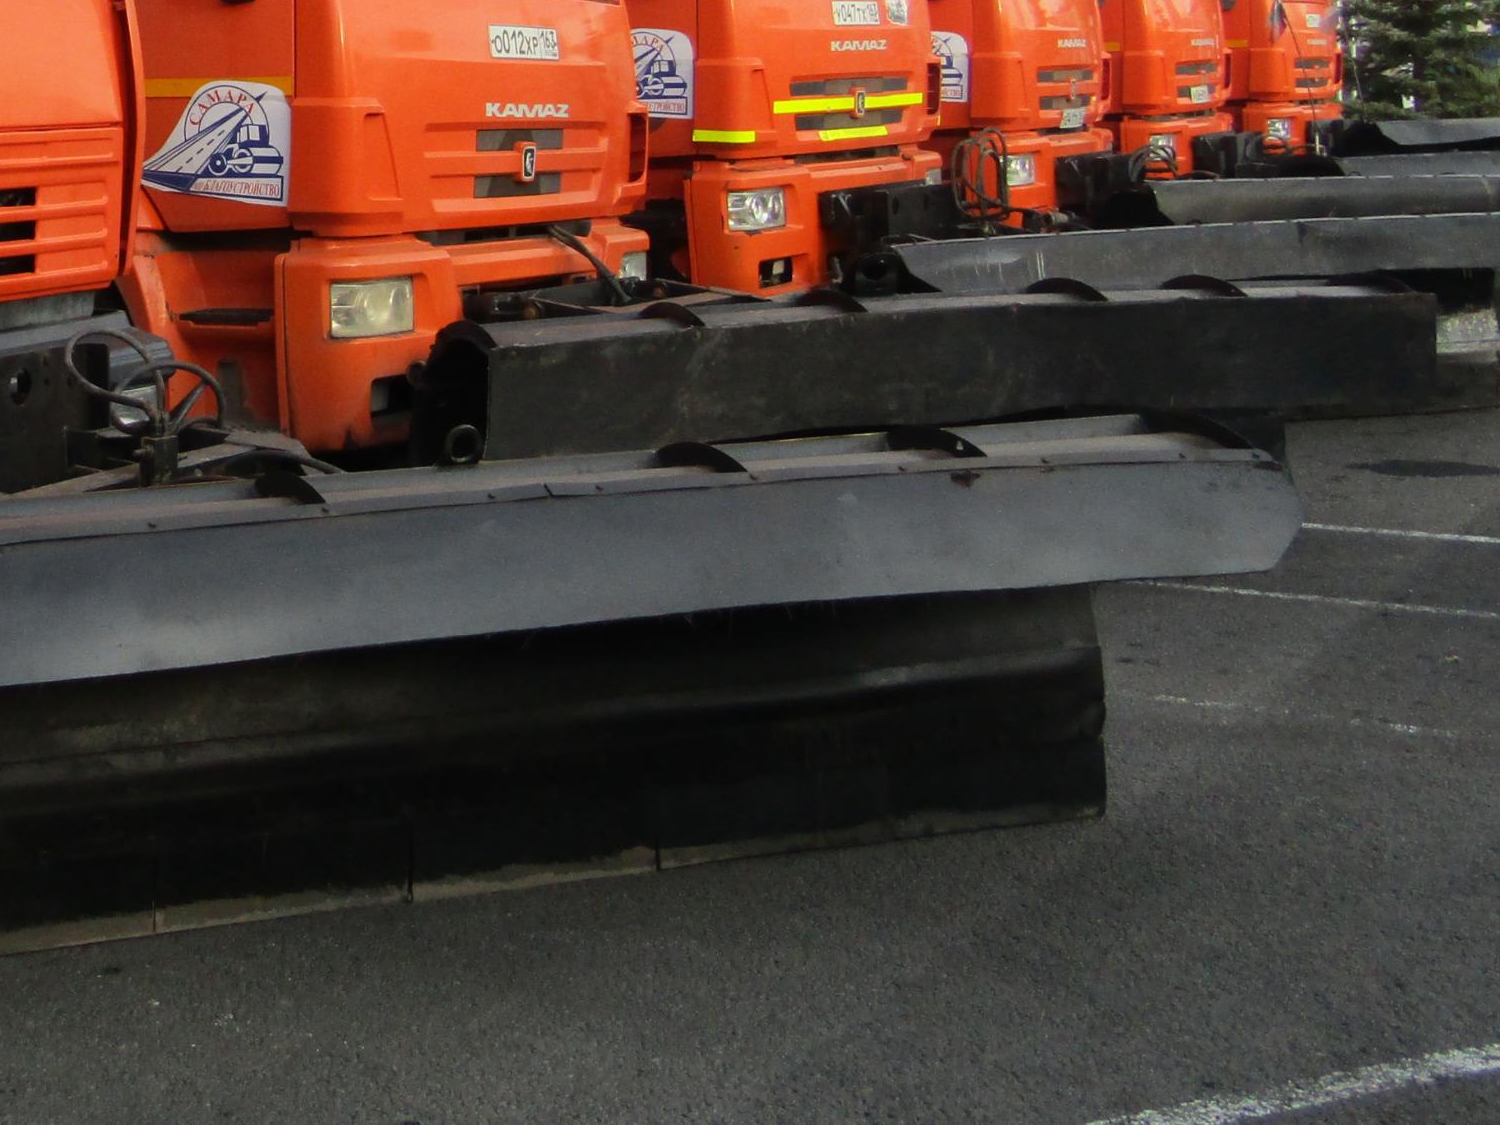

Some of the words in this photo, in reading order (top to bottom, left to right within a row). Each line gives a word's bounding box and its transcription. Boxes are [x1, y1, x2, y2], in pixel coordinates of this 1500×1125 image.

[830, 39, 887, 51] KAMAZ
[189, 90, 258, 126] САМАРА
[485, 102, 570, 118] KAMAZ
